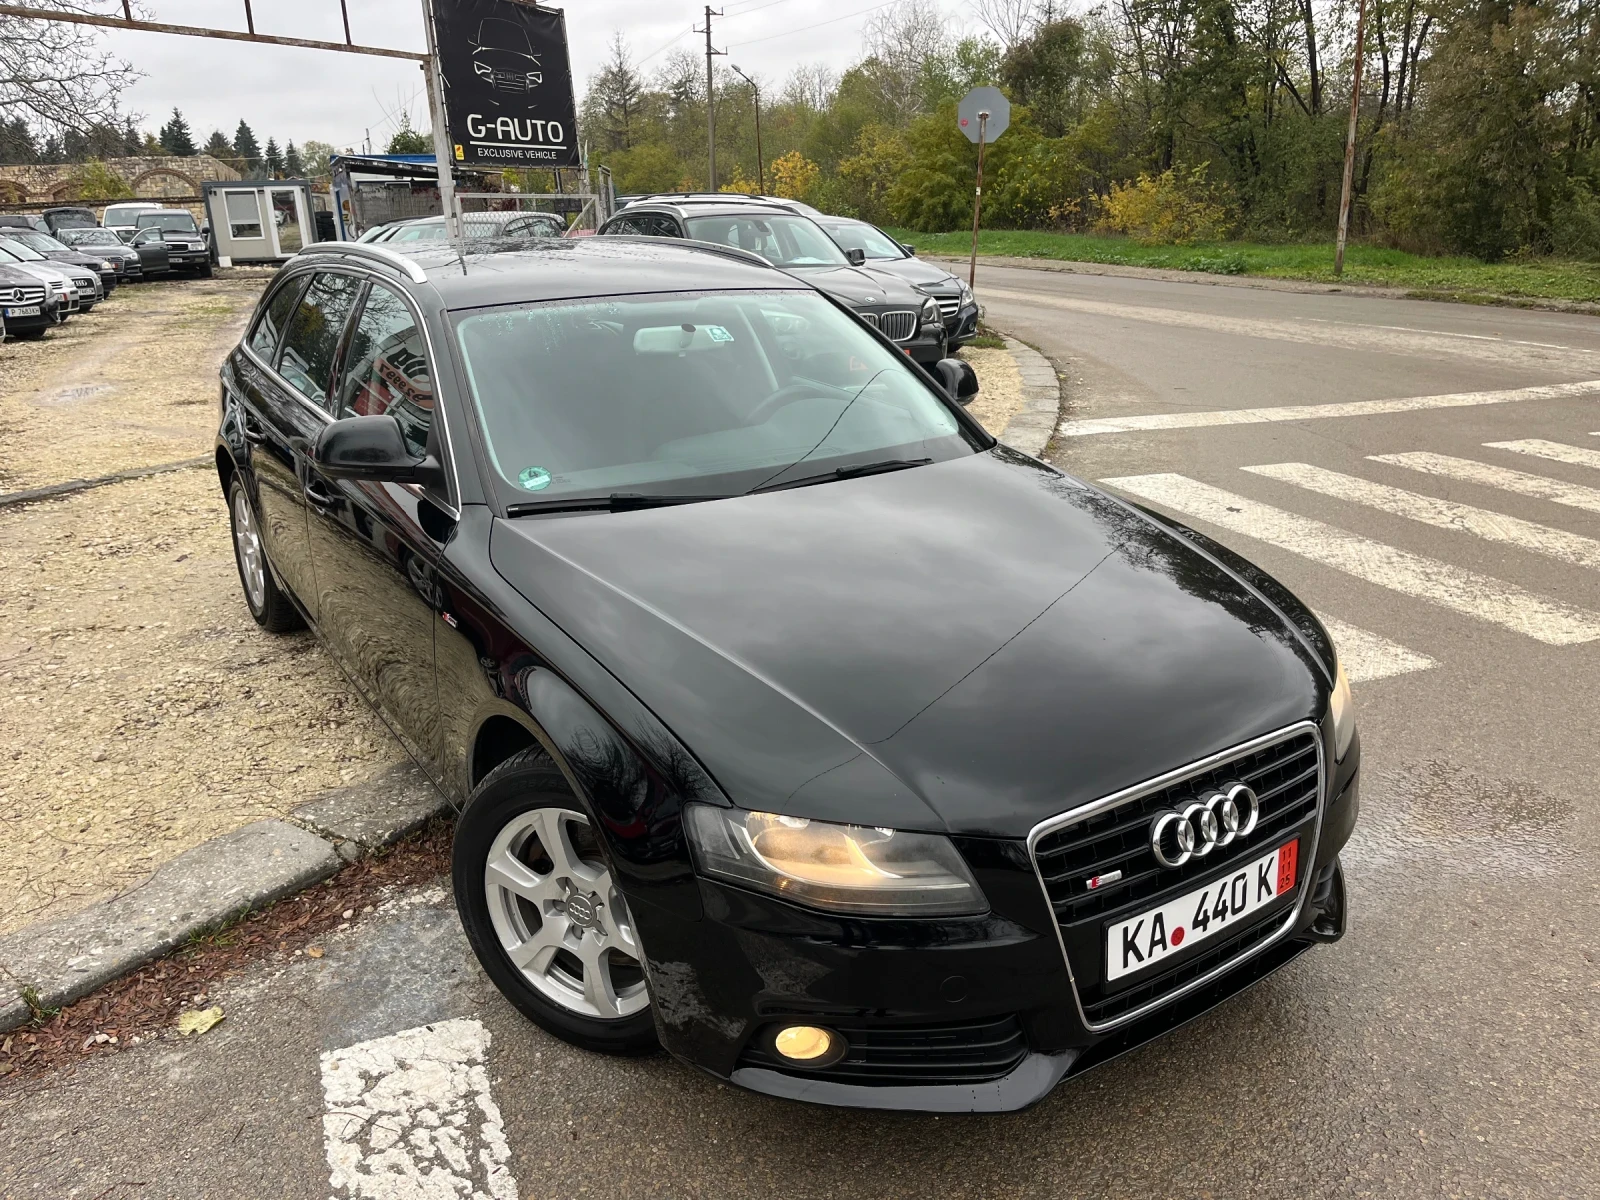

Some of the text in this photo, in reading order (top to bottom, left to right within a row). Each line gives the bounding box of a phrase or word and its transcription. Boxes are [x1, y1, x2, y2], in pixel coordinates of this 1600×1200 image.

[467, 114, 563, 143] G-AUTO
[477, 147, 557, 160] EXCLUSIVE VEHICLE
[1282, 846, 1292, 862] 11
[1281, 860, 1291, 874] 11
[1279, 874, 1291, 889] 25
[1122, 856, 1274, 969] KA 440 K
